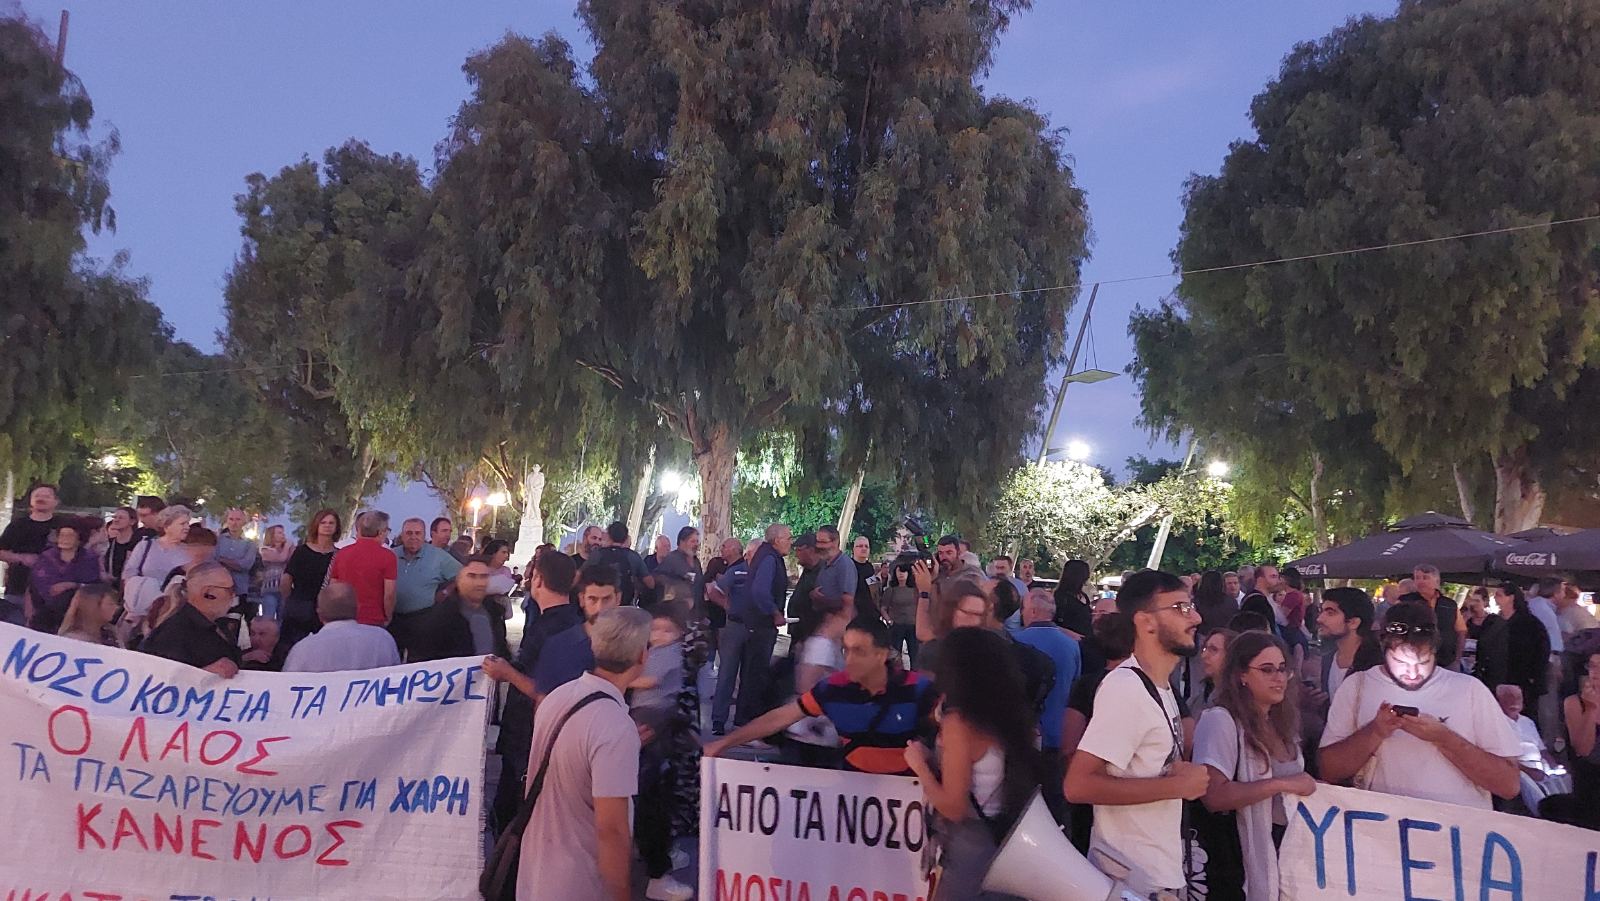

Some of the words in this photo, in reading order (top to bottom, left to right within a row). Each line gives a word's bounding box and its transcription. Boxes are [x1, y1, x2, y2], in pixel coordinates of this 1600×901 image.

[290, 686, 328, 720] ΤΑ
[48, 704, 92, 756] Ο
[119, 716, 292, 776] ΛΑΟΣ
[11, 742, 52, 784] ΤΑ
[73, 758, 327, 817] ΠΑΖΑΡΕΥΟΥΜΕ
[339, 779, 378, 812] ΓΙΑ
[390, 776, 470, 816] ΧΑΡΗ
[76, 803, 365, 867] ΚΑΝΕΝΟΣ
[714, 782, 780, 836] ΑΠΟ
[790, 788, 826, 842] ΤΑ
[836, 794, 925, 853] ΝΟΣΟ
[1297, 800, 1524, 901] ΥΓΕΙΑ
